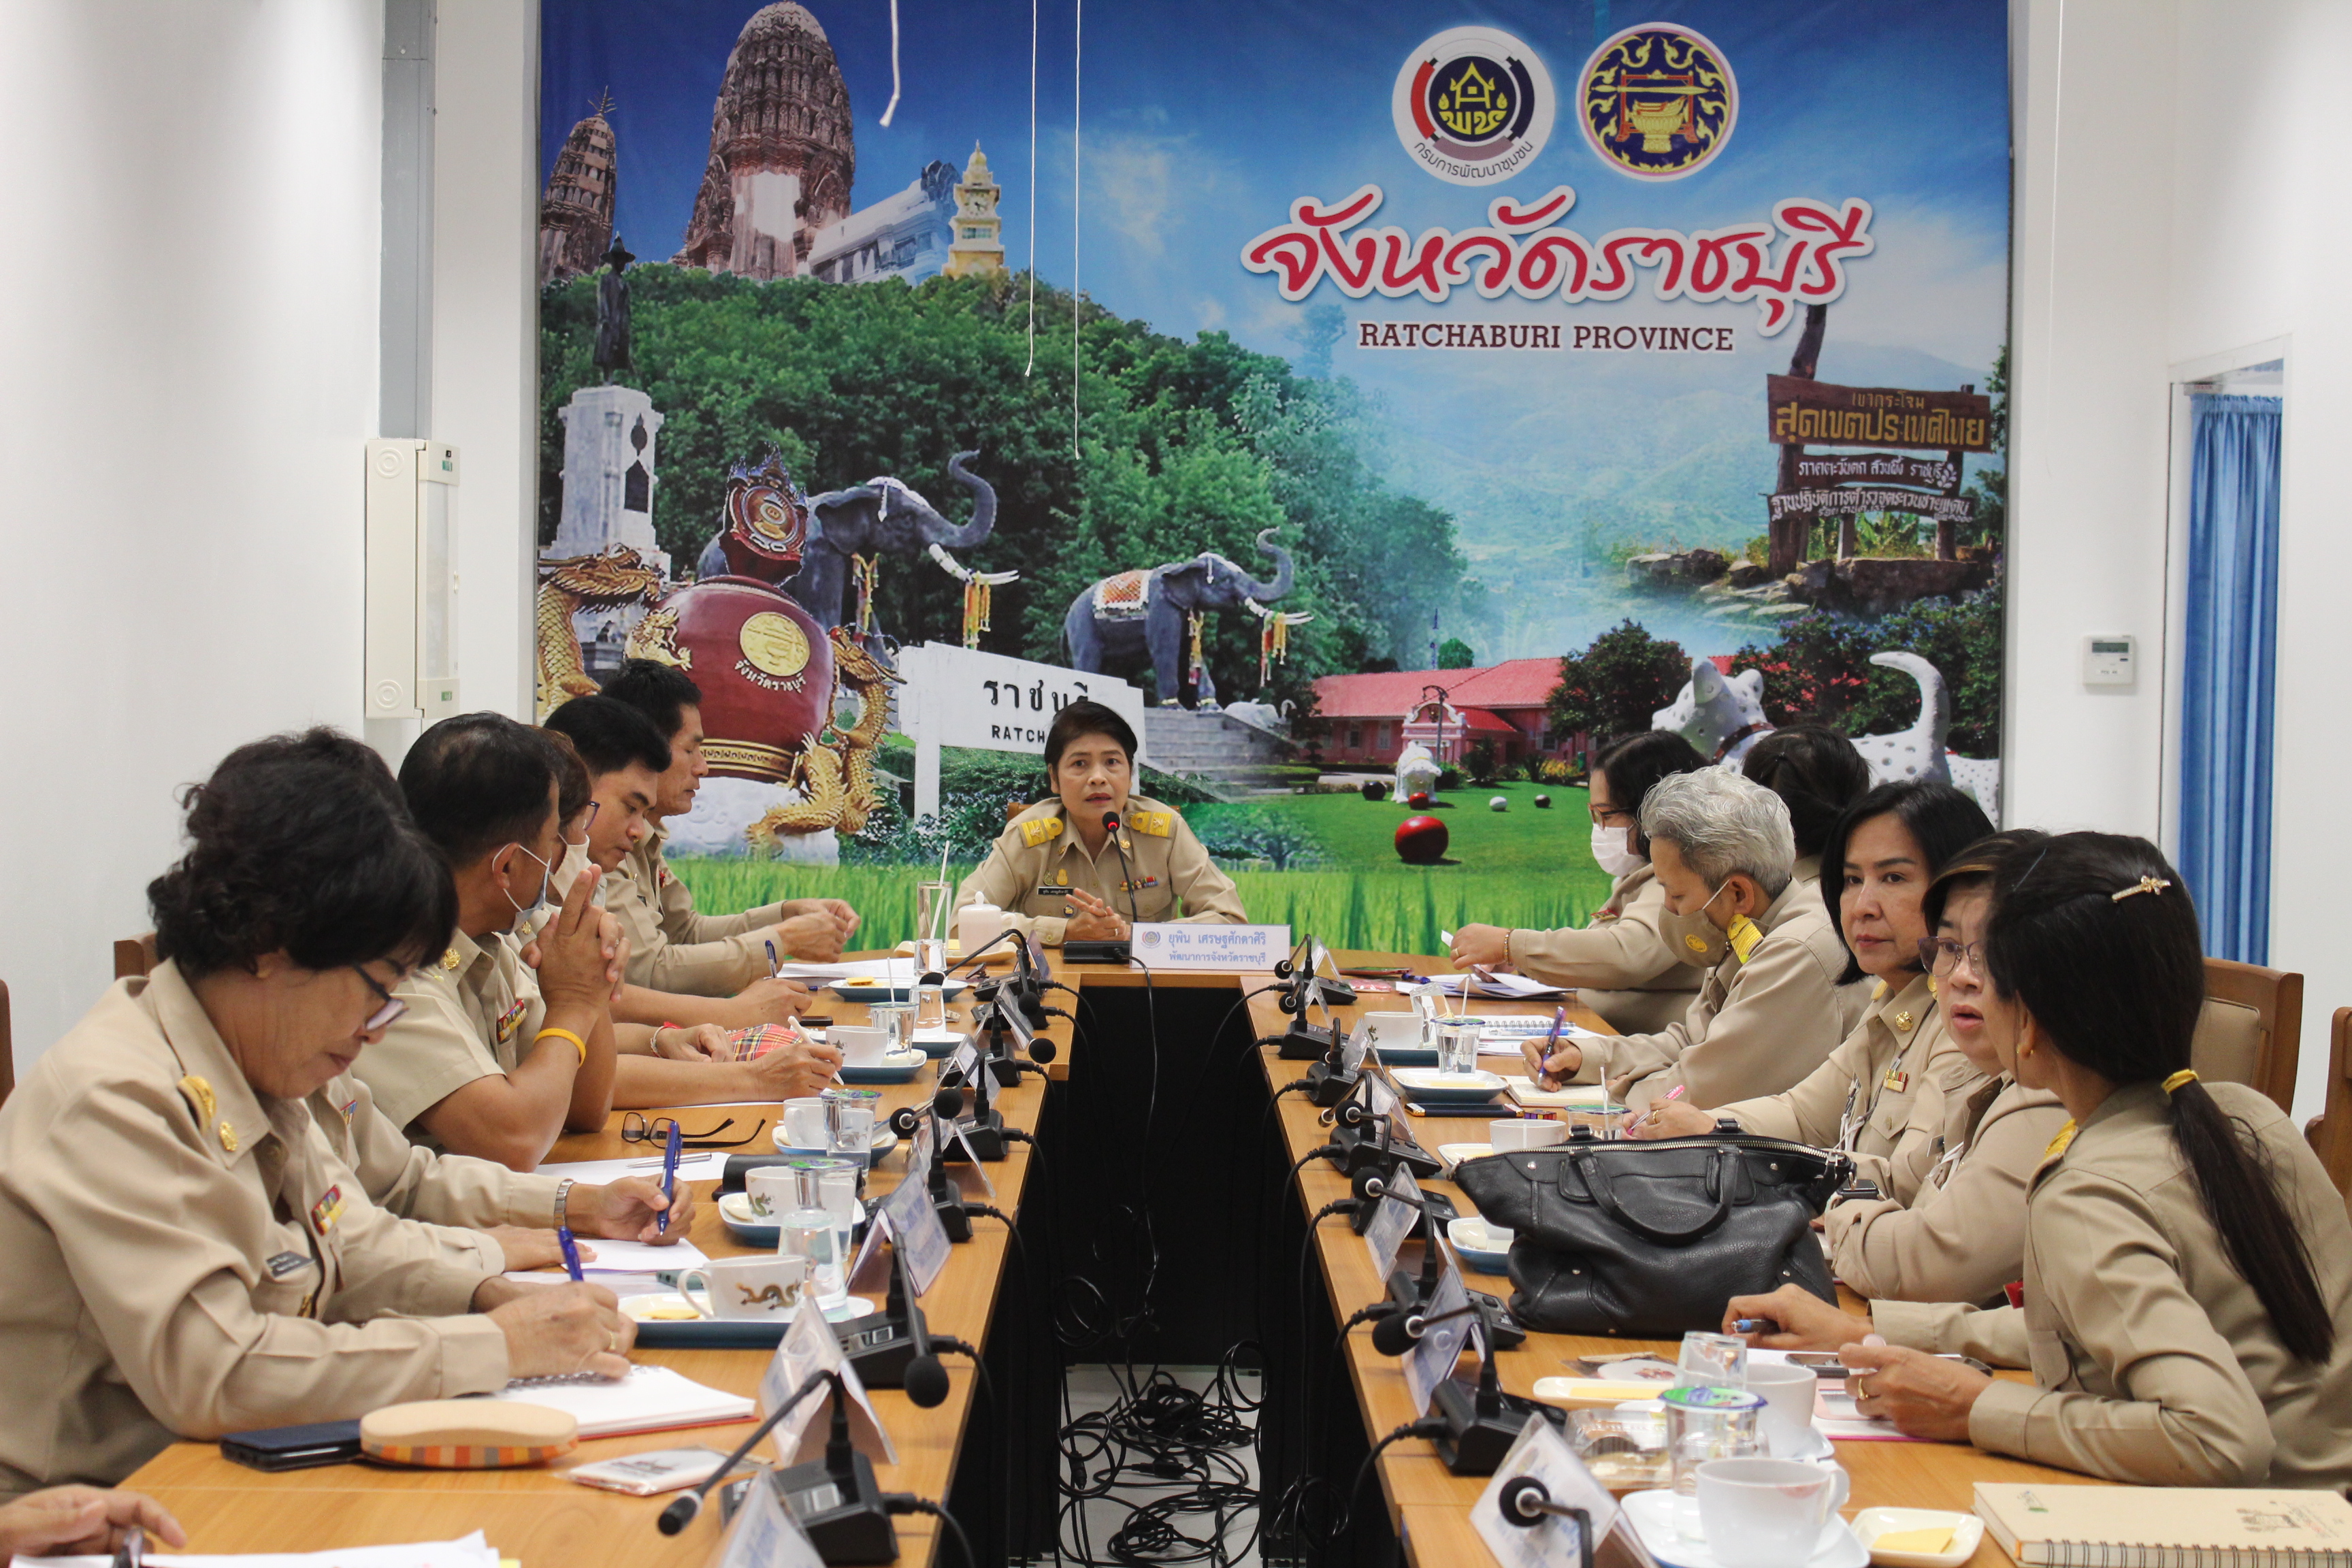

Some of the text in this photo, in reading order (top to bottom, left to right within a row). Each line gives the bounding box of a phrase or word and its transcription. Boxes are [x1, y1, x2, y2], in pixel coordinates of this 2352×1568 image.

[1414, 140, 1533, 178] กรมการพัฒนาชุมชน
[1250, 193, 1865, 328] จังหวัดราชบุรี
[1360, 323, 1733, 350] RATCHABURI PROVINCE
[1776, 402, 1985, 446] สุดเขตประเทศไทย
[991, 724, 1045, 744] RATCH
[1168, 930, 1266, 949] ยุพิน เศรษฐศักดาศิริ
[1169, 951, 1266, 966] พัฒนาการจังหวัดราชบุรี
